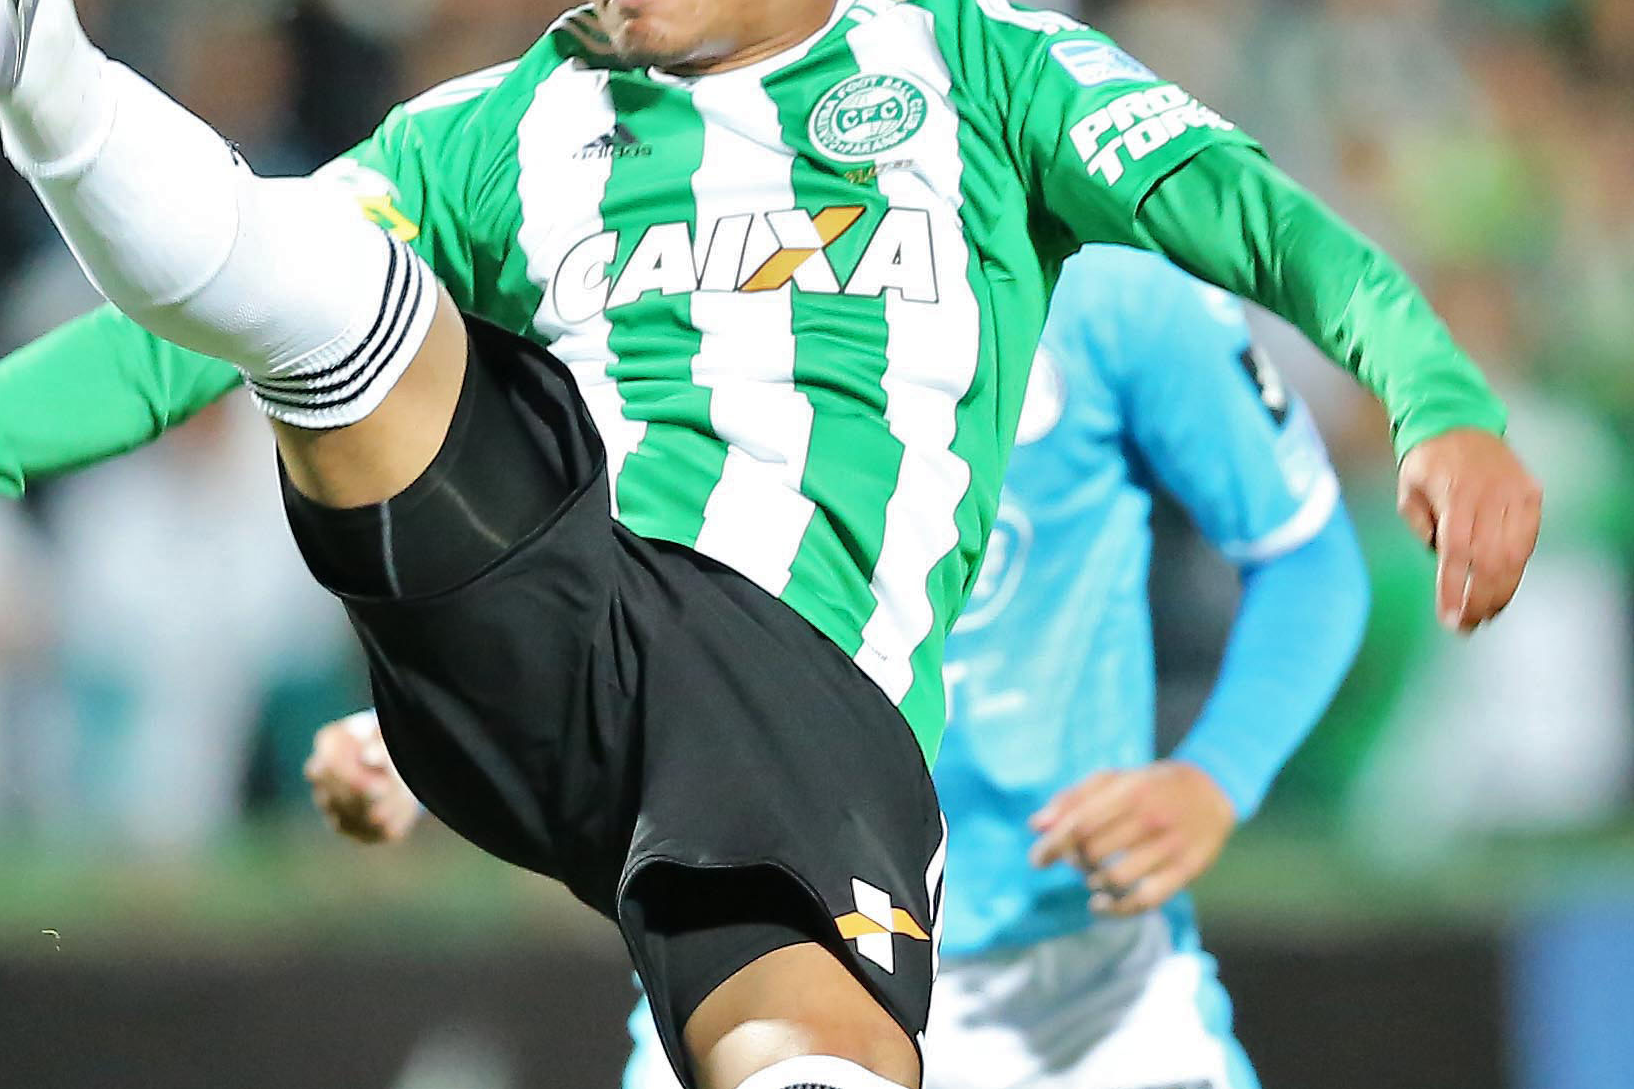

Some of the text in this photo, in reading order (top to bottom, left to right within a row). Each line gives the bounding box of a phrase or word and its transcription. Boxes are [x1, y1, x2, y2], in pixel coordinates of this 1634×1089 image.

[842, 101, 899, 130] CFC
[1069, 84, 1190, 163] PRO
[553, 205, 940, 325] CAIXA
